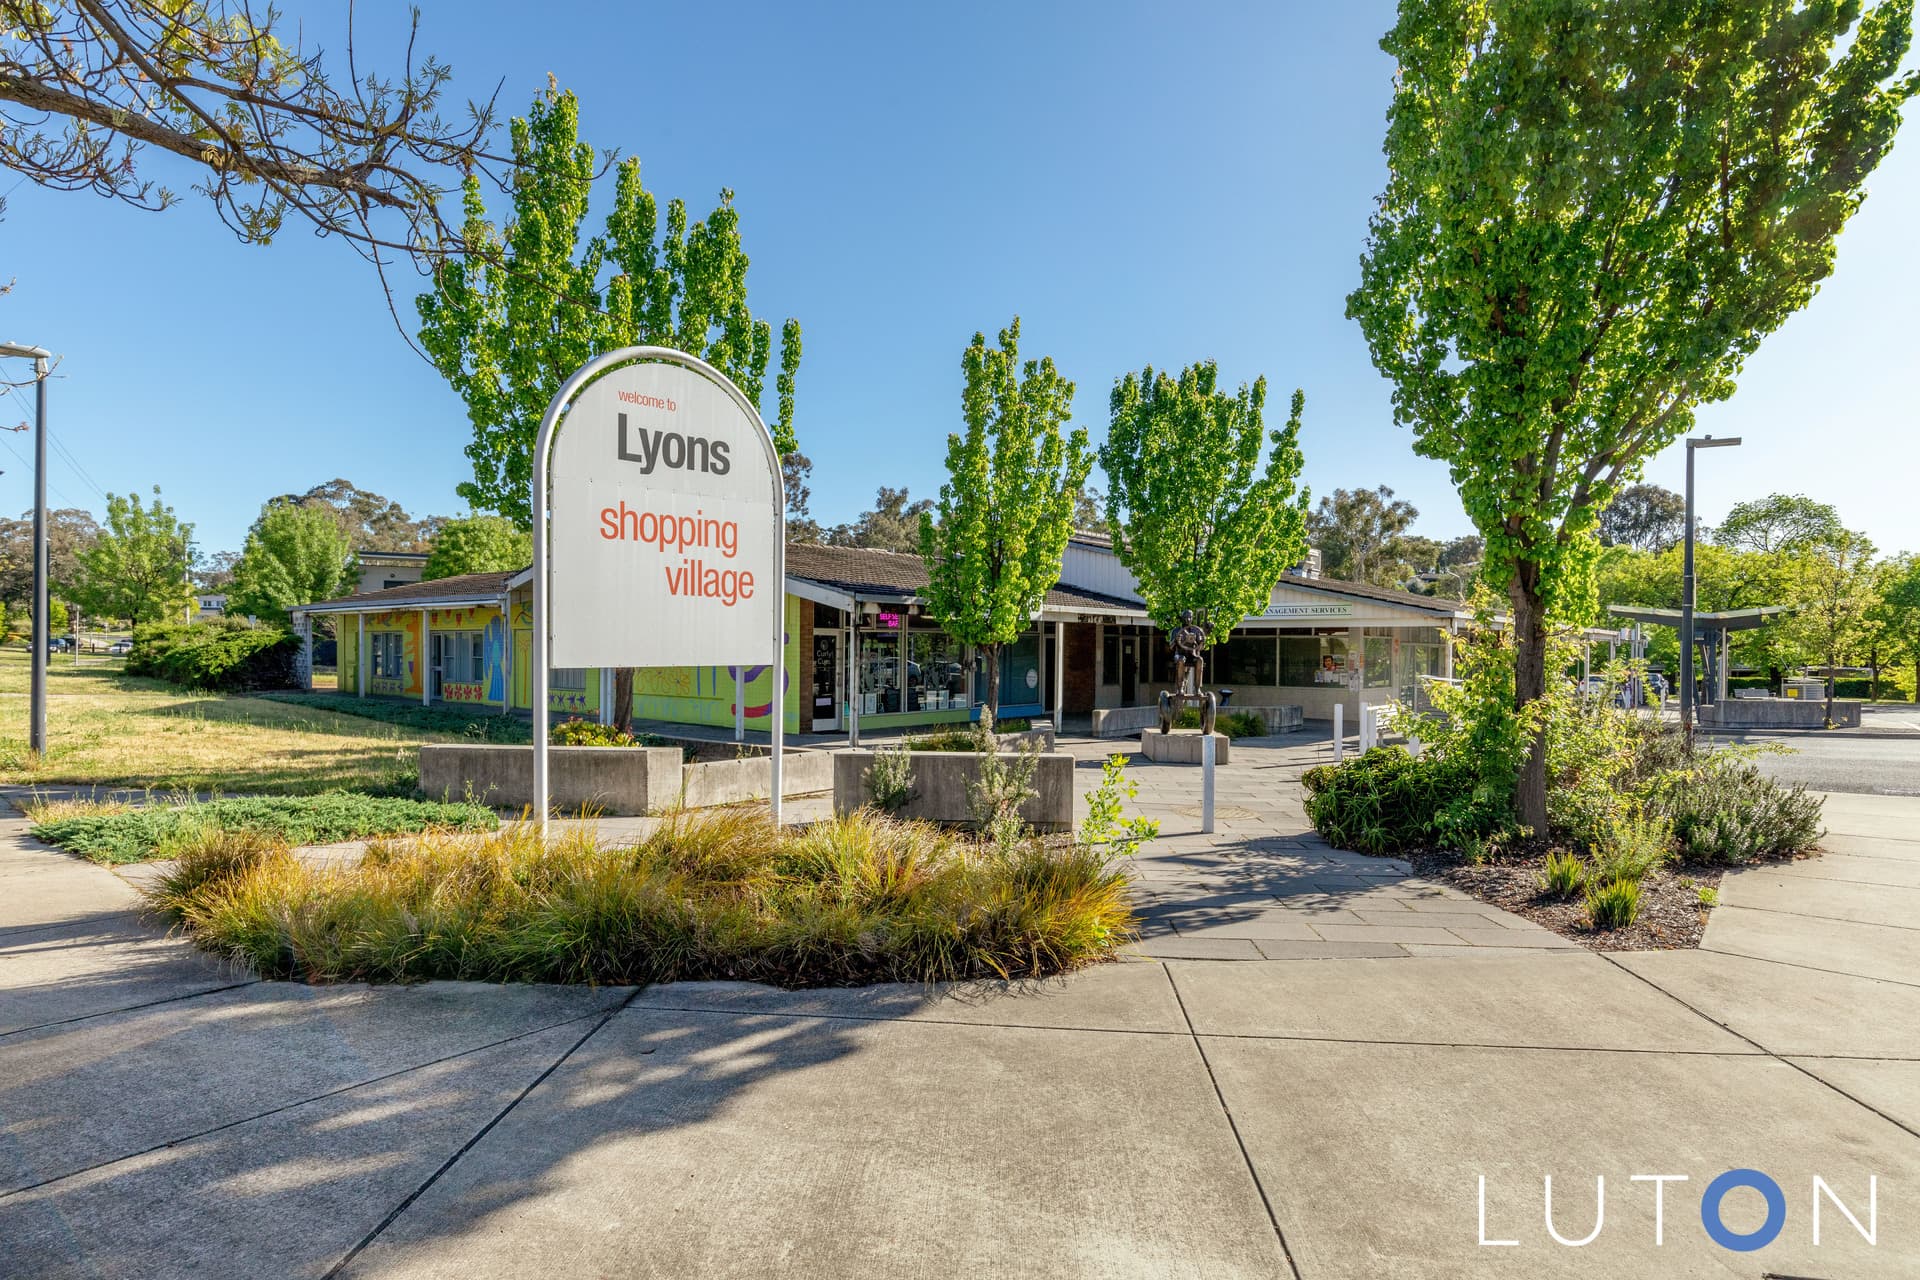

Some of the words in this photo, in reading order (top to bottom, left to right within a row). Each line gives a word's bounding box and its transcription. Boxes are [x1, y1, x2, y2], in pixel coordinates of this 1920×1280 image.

[618, 390, 665, 409] welcome
[667, 398, 676, 412] to
[617, 413, 730, 475] Lyons
[600, 501, 738, 558] shopping
[665, 559, 754, 607] village
